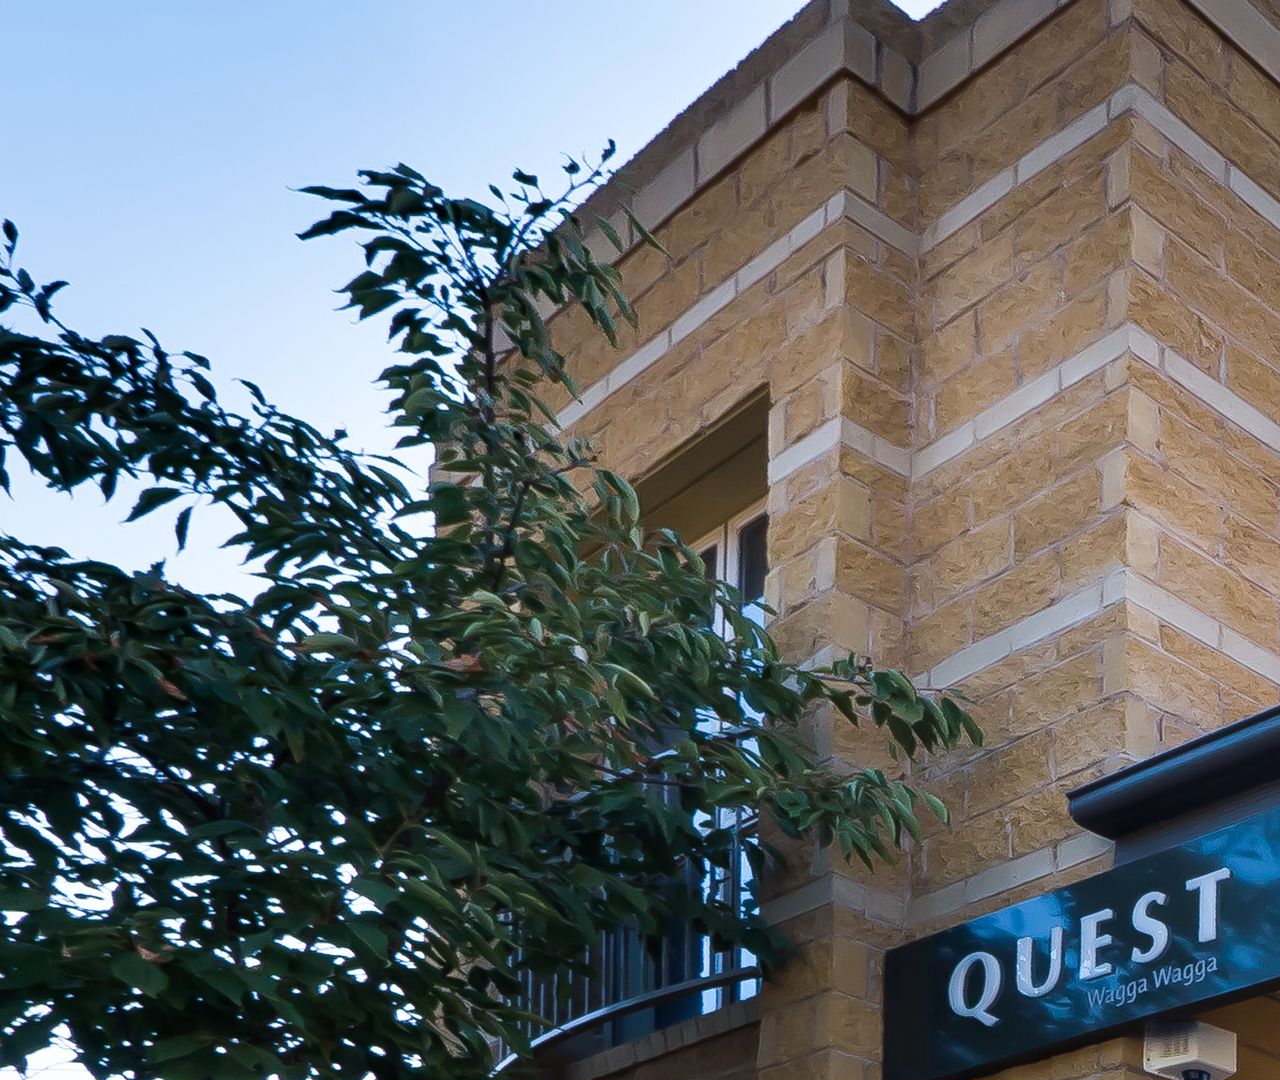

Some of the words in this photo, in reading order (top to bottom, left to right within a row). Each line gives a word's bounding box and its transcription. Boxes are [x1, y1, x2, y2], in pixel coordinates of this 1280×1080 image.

[948, 867, 1231, 1028] QUEST
[1087, 978, 1148, 1007] Wagga
[1152, 957, 1218, 988] Wagga
